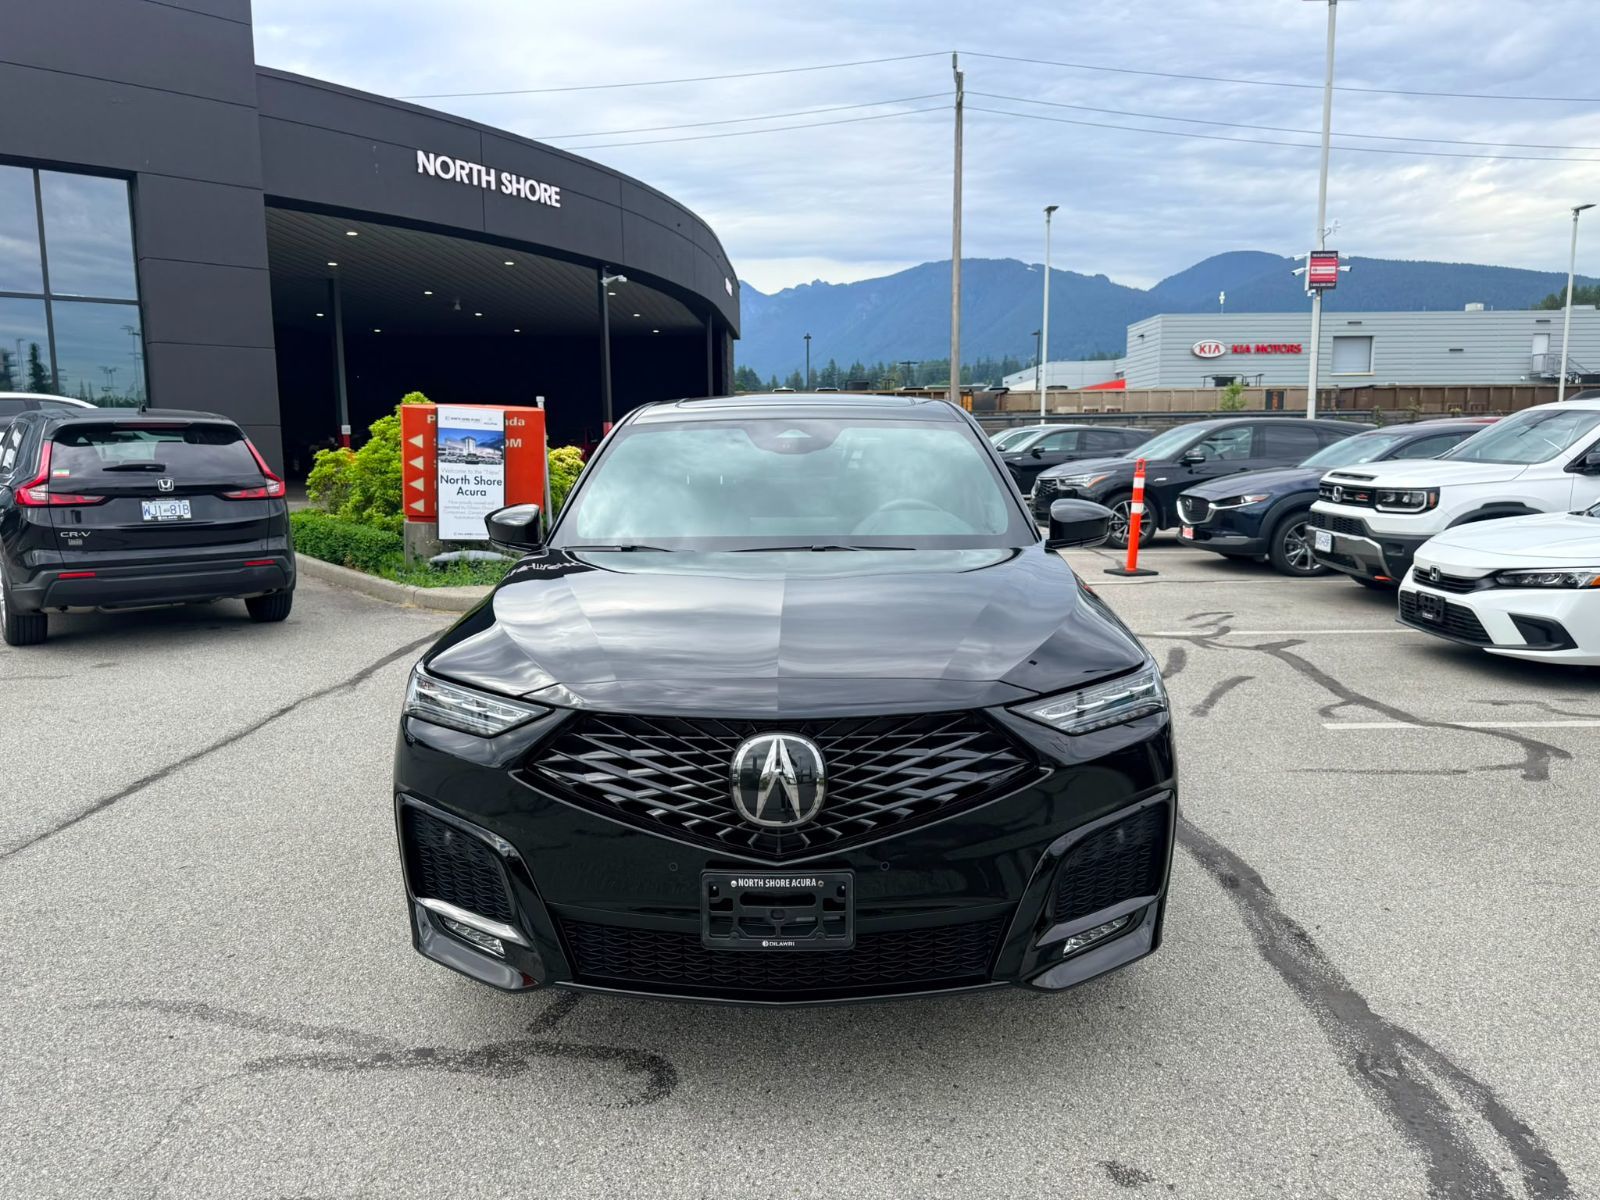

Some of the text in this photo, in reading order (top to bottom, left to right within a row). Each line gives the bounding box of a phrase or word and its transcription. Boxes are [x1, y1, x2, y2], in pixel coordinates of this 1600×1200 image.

[416, 150, 561, 208] NORTH SHORE
[1199, 344, 1221, 354] KIA
[1231, 344, 1302, 354] KIA MOTORS
[440, 474, 470, 485] North
[474, 475, 503, 486] Shore
[456, 486, 487, 496] Acura
[738, 878, 817, 887] NORTH SHORE ACURA
